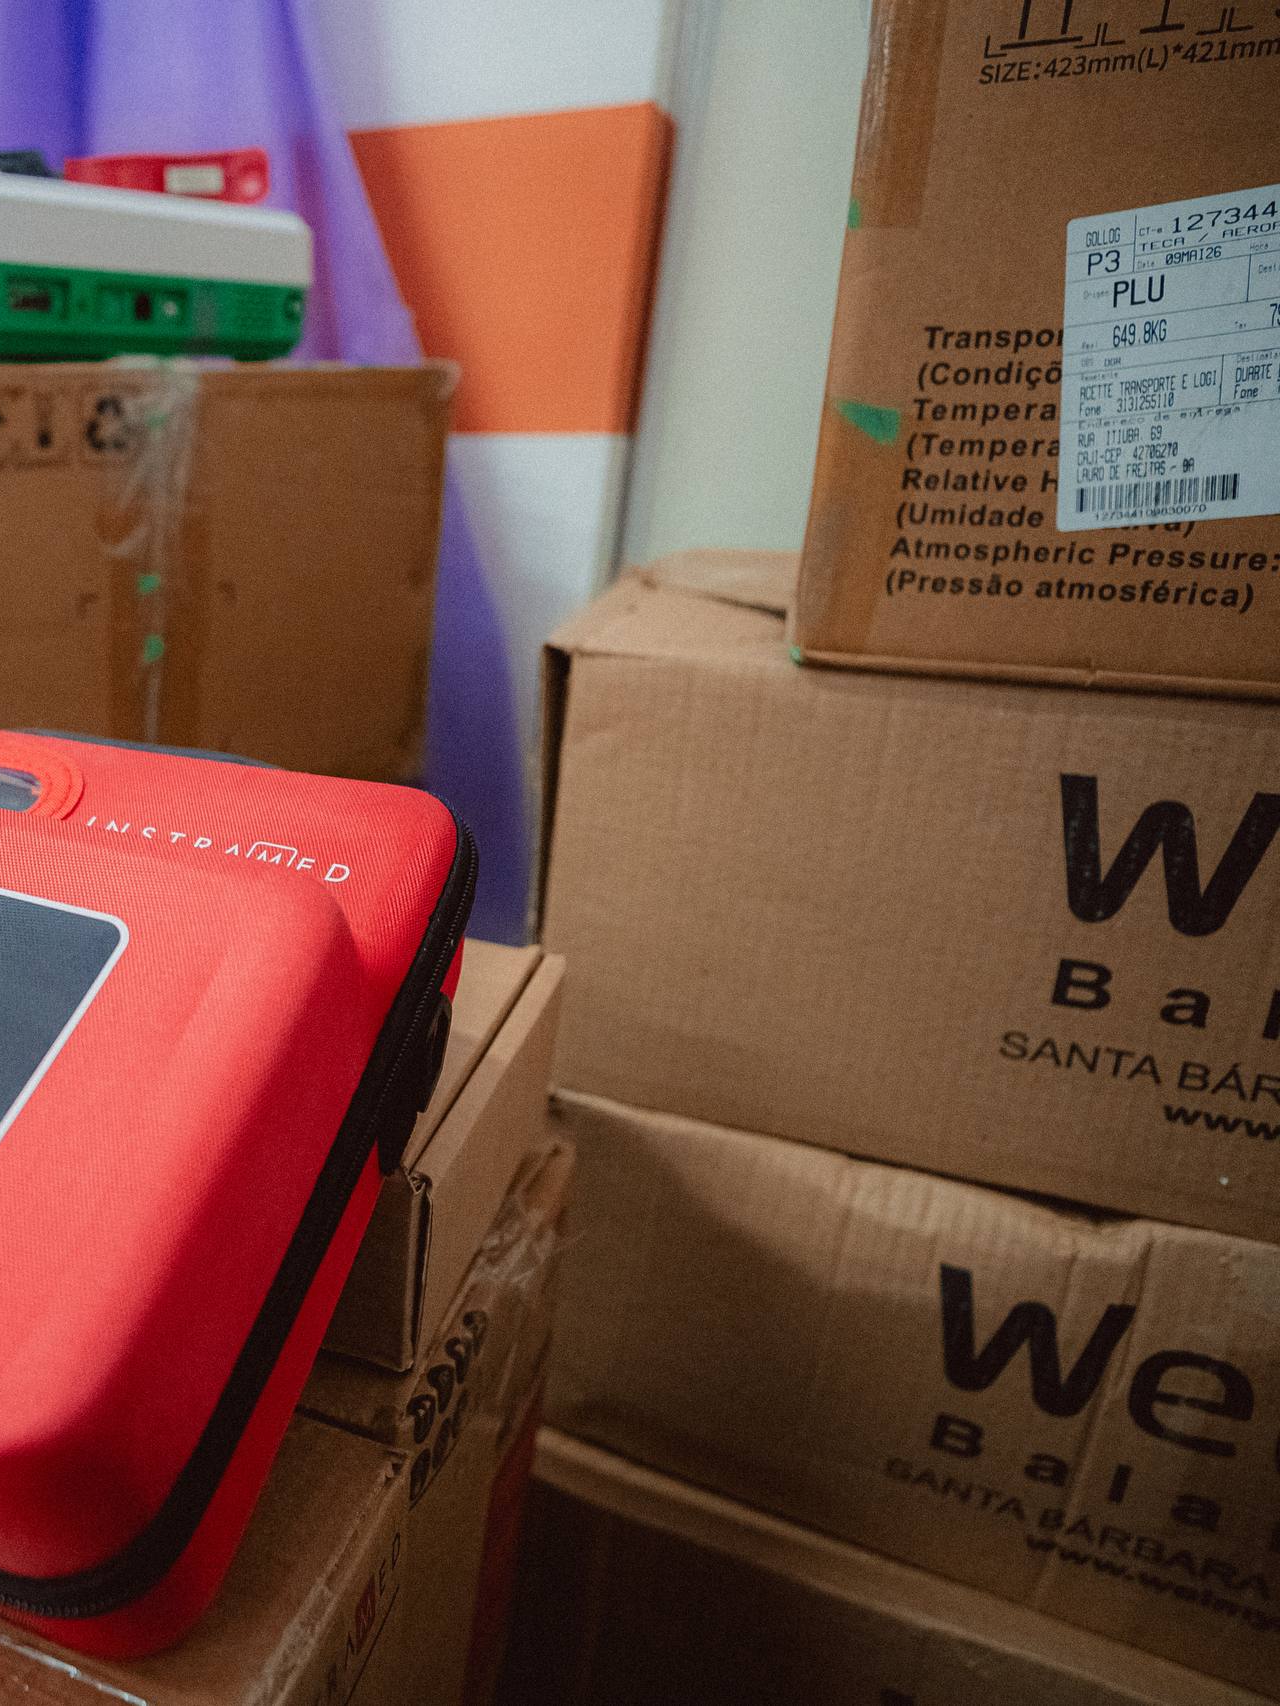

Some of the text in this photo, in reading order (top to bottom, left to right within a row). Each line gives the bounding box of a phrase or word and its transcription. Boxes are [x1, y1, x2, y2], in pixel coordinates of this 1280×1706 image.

[1172, 200, 1278, 234] 127344
[1086, 228, 1121, 248] GOLLOG
[1141, 237, 1185, 252] TECA
[1088, 250, 1120, 276] P3
[1165, 246, 1223, 266] 09MAI26
[1112, 274, 1165, 308] PLU
[1112, 318, 1168, 348] 649.8KG
[1120, 375, 1176, 396] TRANSPORTE
[1182, 374, 1188, 390] E
[1194, 370, 1218, 388] LOGI
[1235, 363, 1274, 383] DUARTE
[913, 398, 1057, 427] Tempera
[1078, 432, 1096, 448] RUA
[901, 468, 1028, 493] Relative
[1076, 466, 1105, 484] LAURO
[1108, 464, 1121, 480] DE
[1126, 460, 1166, 479] FREITAS
[896, 502, 1044, 530] (Umidade
[889, 537, 1280, 573] Atmospheric Pressure:
[886, 568, 1255, 614] (Pressão atmosférica)
[999, 1031, 1163, 1085] SANTA
[883, 1456, 1025, 1521] SANTA
